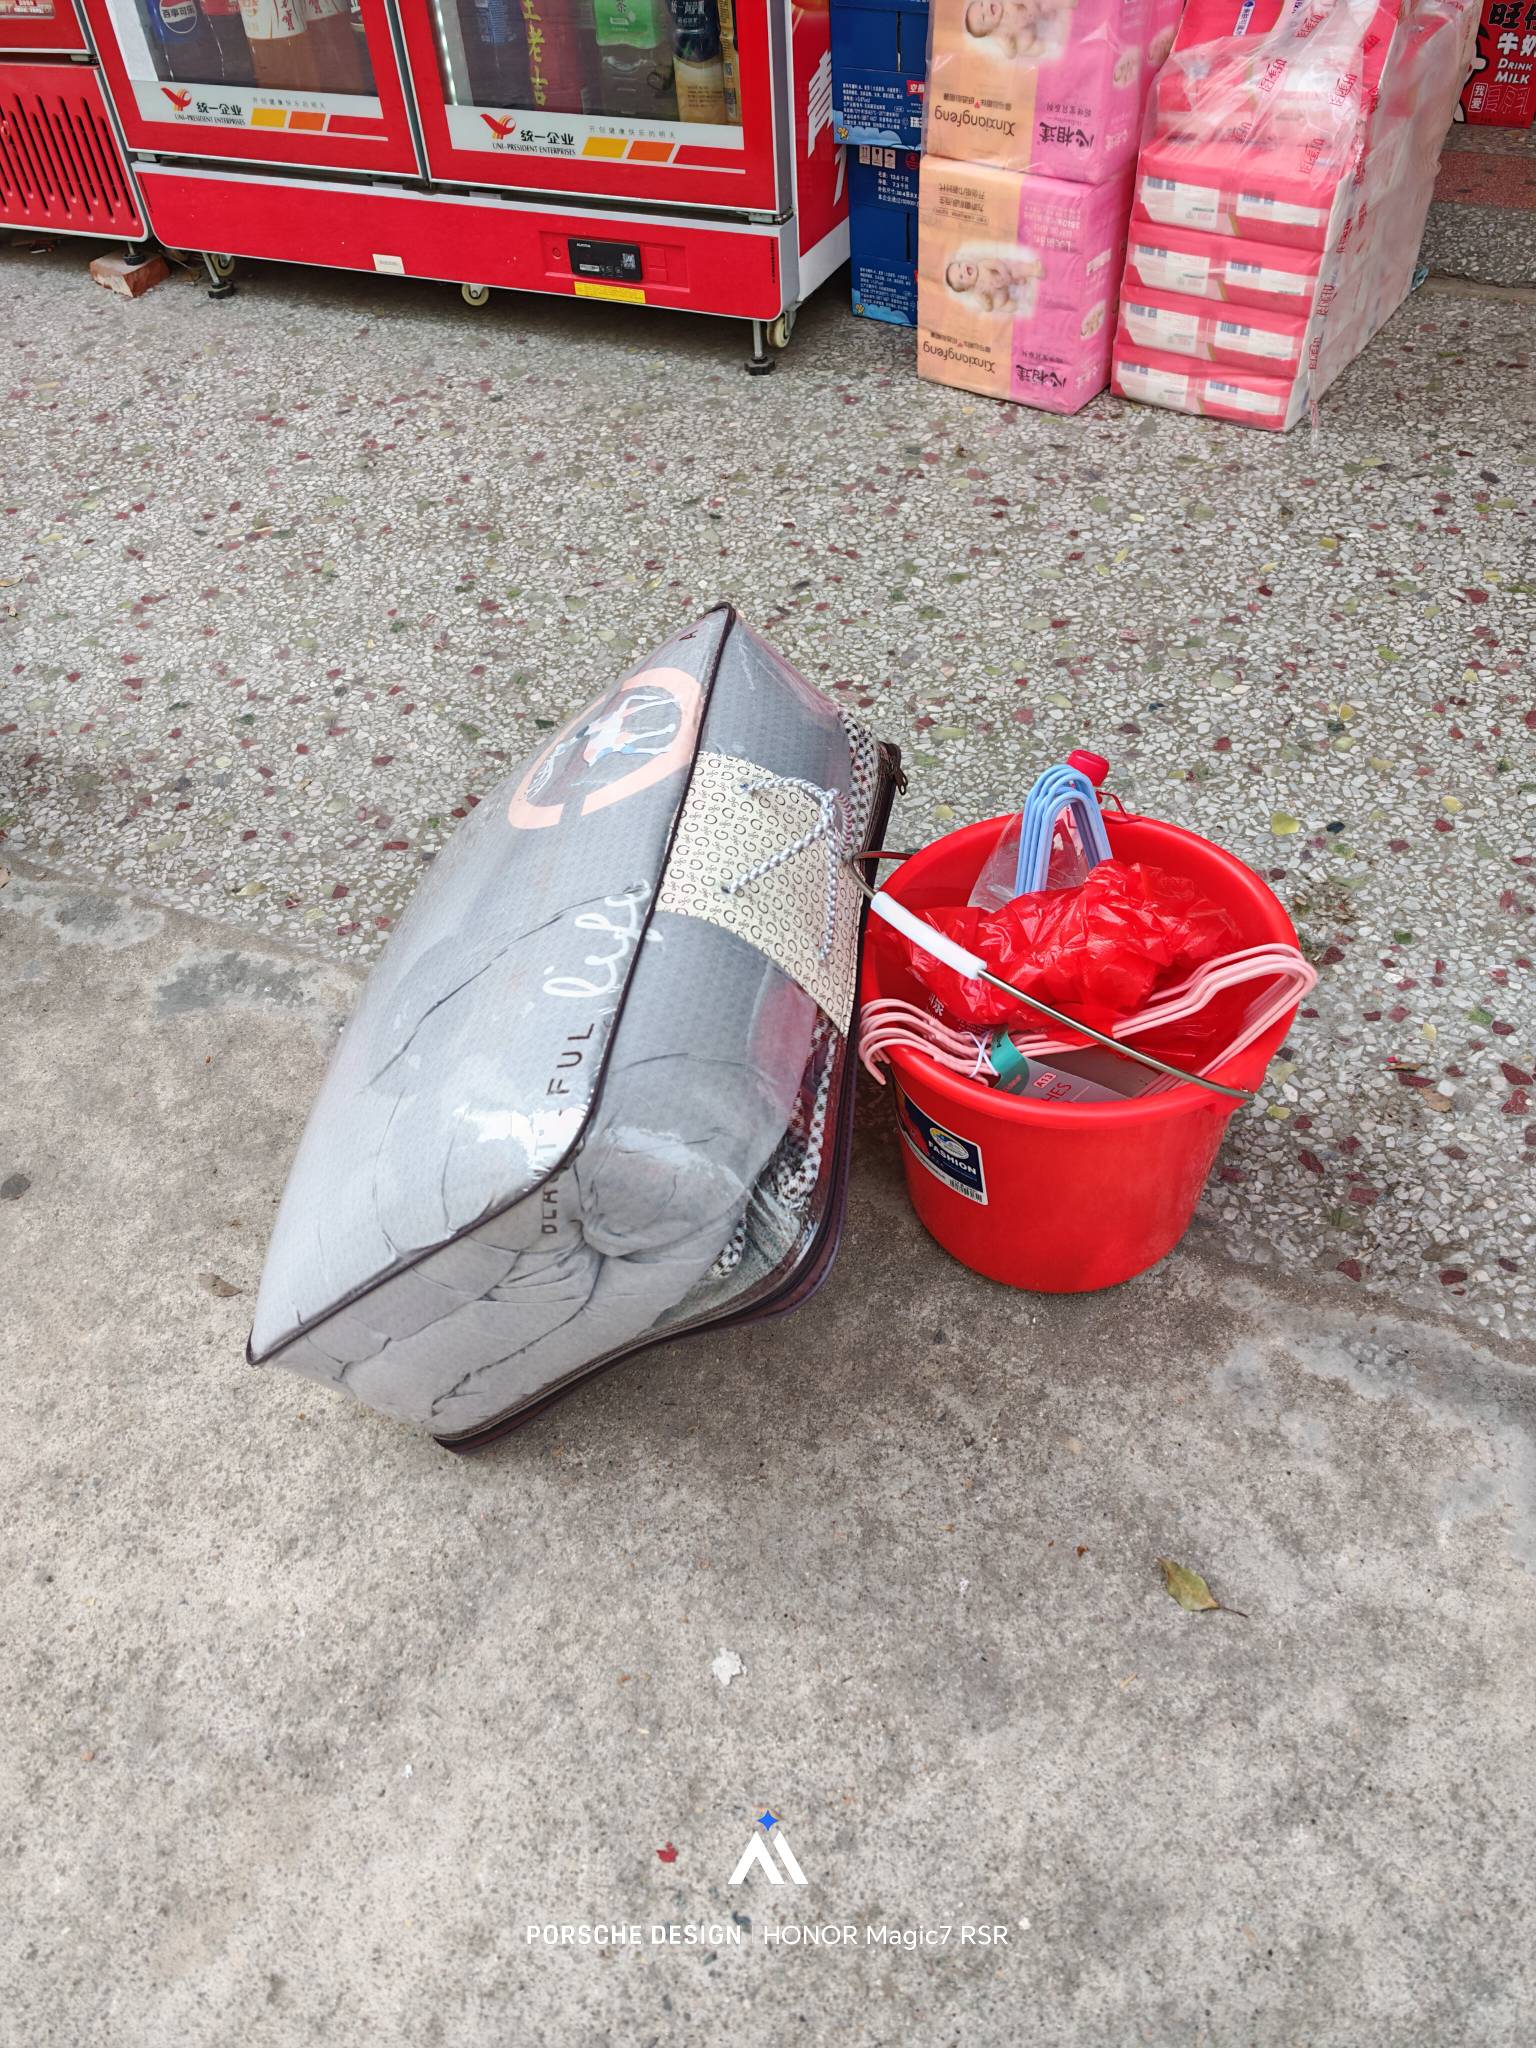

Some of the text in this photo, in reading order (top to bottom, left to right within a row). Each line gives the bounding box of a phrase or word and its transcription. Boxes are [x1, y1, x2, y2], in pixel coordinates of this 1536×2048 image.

[162, 5, 194, 18] 百事可乐
[1497, 58, 1533, 71] DRINK
[1494, 71, 1531, 84] MILK
[196, 101, 244, 116] 统一企业
[934, 105, 1017, 137] Xinxiangfeng
[519, 129, 576, 146] 统一企业
[1039, 121, 1095, 149] 心相逢
[492, 142, 576, 156] UNI-PRESIDENT ENTERPRISES
[922, 341, 996, 374] Xinxiangfeng
[1015, 364, 1067, 388] 心相逢
[1035, 1073, 1054, 1088] A13
[928, 1140, 977, 1176] FASHION
